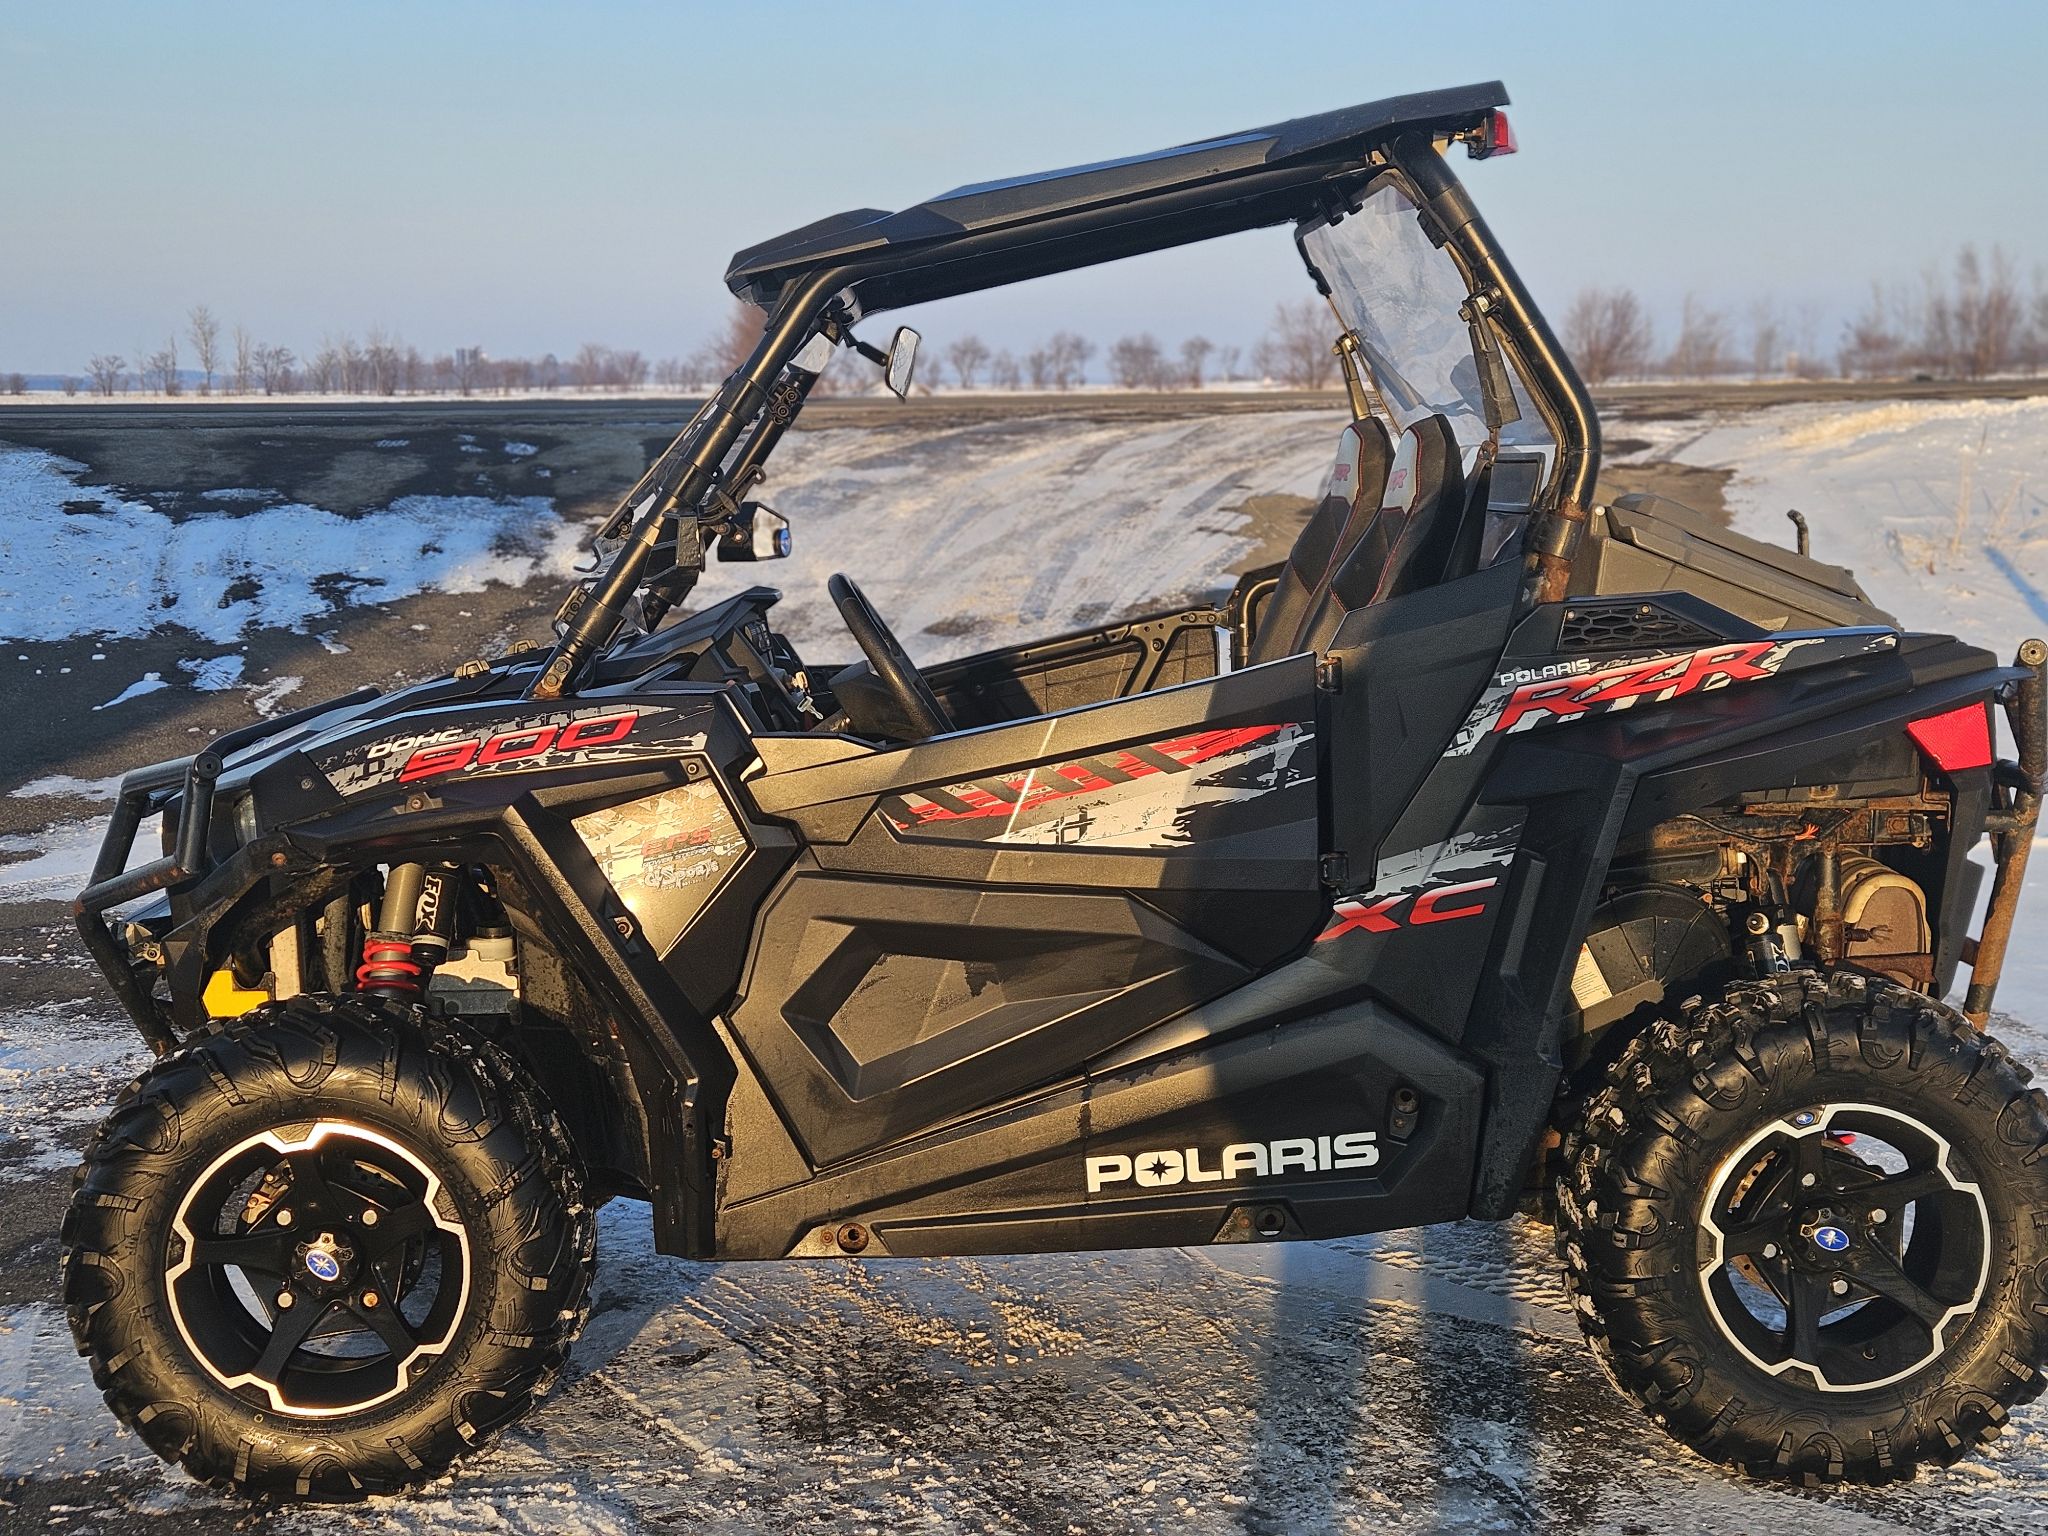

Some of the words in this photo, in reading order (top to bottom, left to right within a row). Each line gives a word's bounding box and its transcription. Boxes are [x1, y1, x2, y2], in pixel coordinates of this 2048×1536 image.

[1492, 641, 1778, 734] RZR
[1500, 658, 1591, 687] POLARIS
[367, 728, 464, 760] DOHC
[398, 711, 639, 784] 900
[641, 827, 711, 856] EPS
[415, 874, 443, 931] FOX
[1313, 877, 1498, 943] XC
[1085, 1131, 1380, 1193] POLARIS
